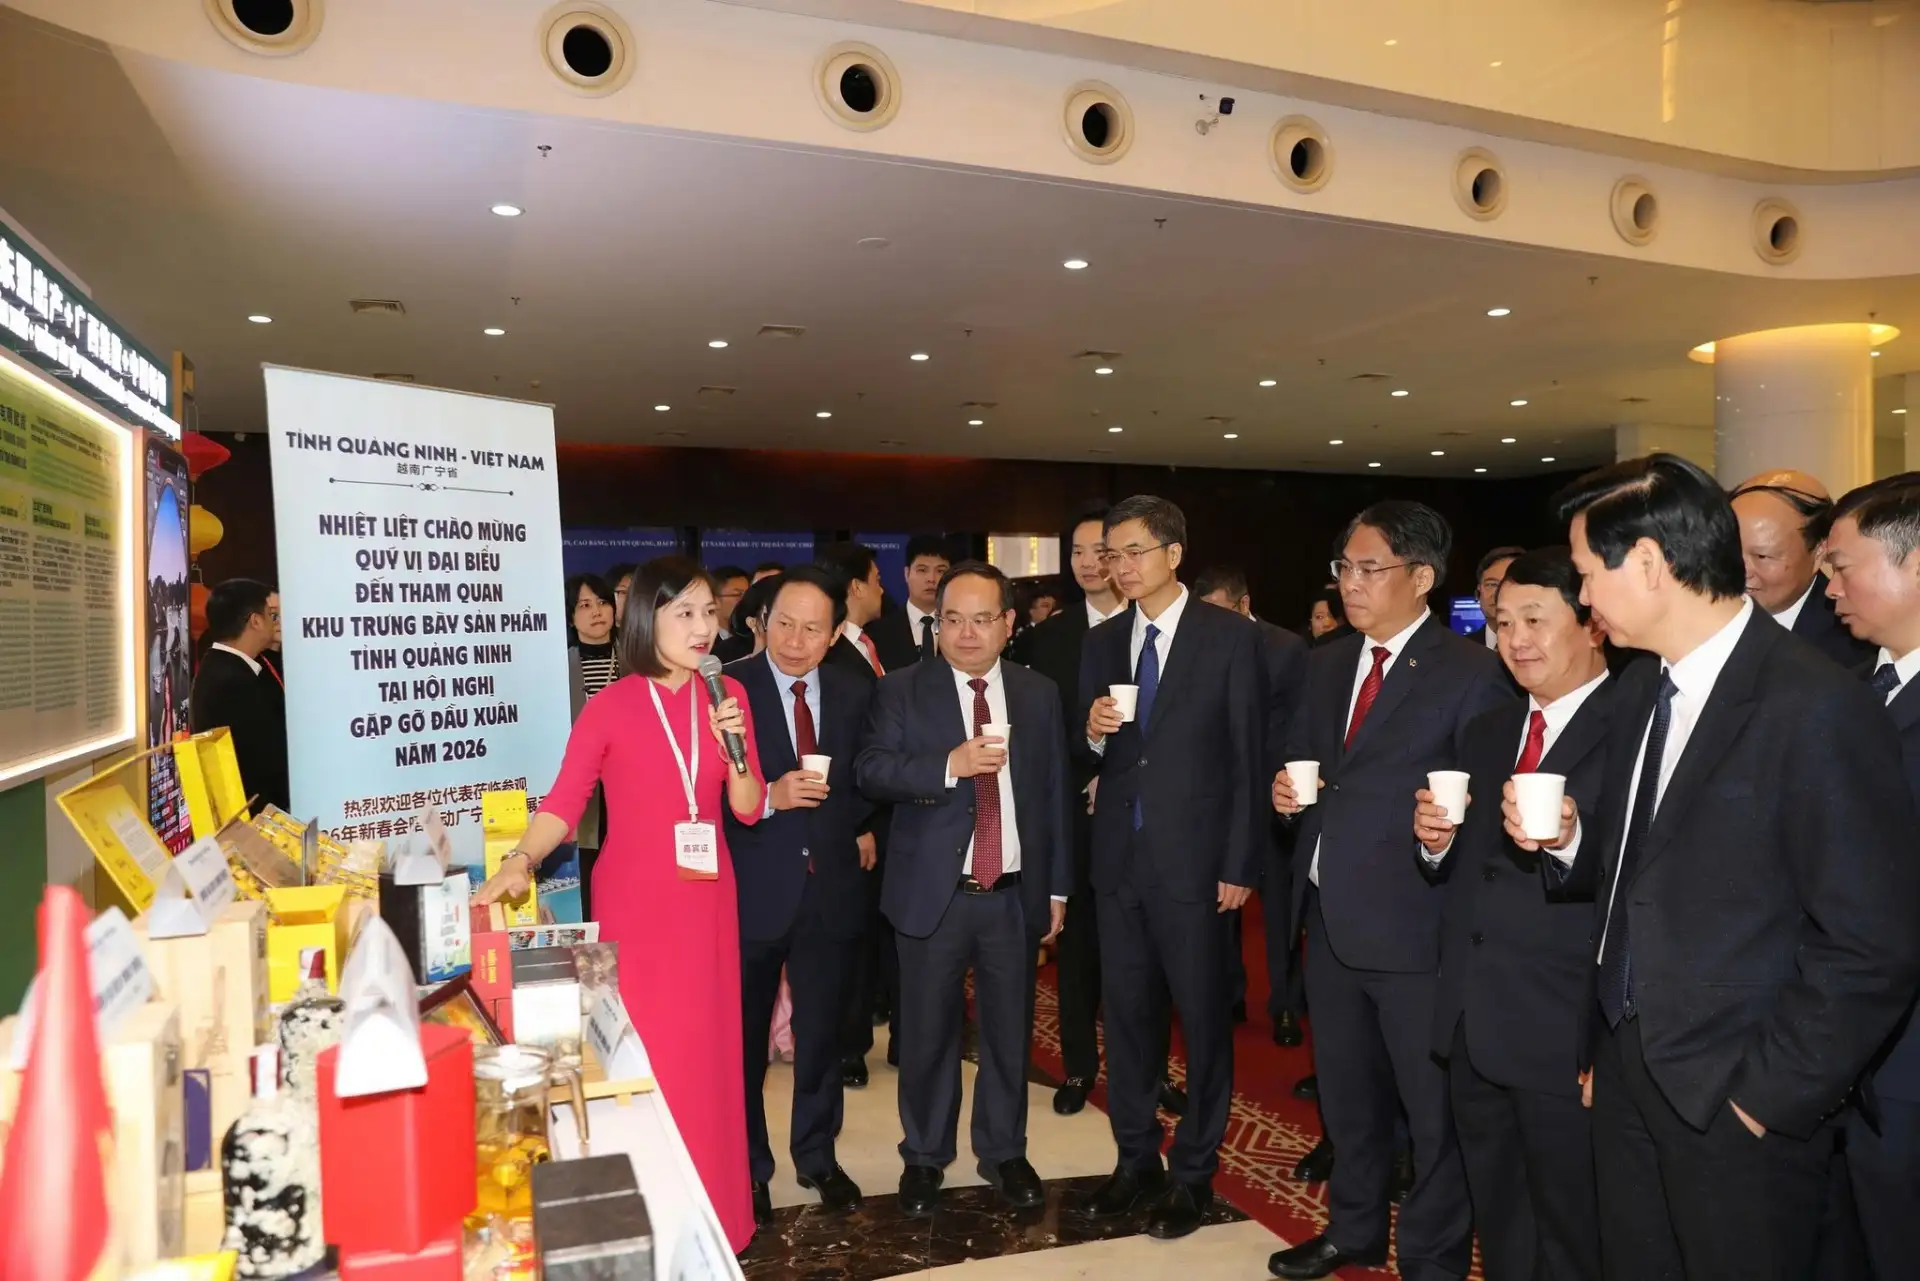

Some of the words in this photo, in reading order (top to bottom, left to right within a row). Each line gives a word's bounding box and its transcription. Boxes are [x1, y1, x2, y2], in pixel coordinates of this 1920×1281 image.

[286, 428, 332, 451] TỈNH
[337, 435, 409, 459] QUẢNG
[414, 444, 457, 462] NINH
[471, 450, 504, 468] VIỆT
[507, 453, 544, 471] NAM
[396, 463, 458, 478] 越南广宁省
[319, 512, 377, 539] NHIỆT
[384, 513, 418, 540] LIỆT
[424, 517, 473, 540] CHÀO
[478, 519, 526, 542] MỪNG
[356, 547, 399, 571] QUÝ
[404, 550, 422, 573] VỊ
[428, 551, 459, 573] ĐẠI
[465, 545, 500, 571] BIỂU
[356, 577, 393, 603] ĐẾN
[399, 583, 451, 603] THAM
[457, 583, 503, 604] QUAN
[302, 616, 344, 638] KHU
[350, 614, 416, 637] TRƯNG
[422, 611, 459, 635] BÀY
[464, 610, 496, 633] SẢN
[501, 606, 548, 632] PHẨM
[350, 644, 396, 670] TỈNH
[402, 642, 467, 669] QUẢNG
[473, 644, 512, 664] NINH
[378, 681, 407, 704] TẠI
[413, 675, 446, 701] HỘI
[452, 675, 494, 697] NGHỊ
[350, 711, 393, 740] GẶP
[398, 709, 426, 734] GỠ
[431, 703, 468, 730] ĐẦU
[474, 701, 518, 726] XUÂN
[395, 741, 436, 767] NĂM
[443, 738, 487, 761] 2026
